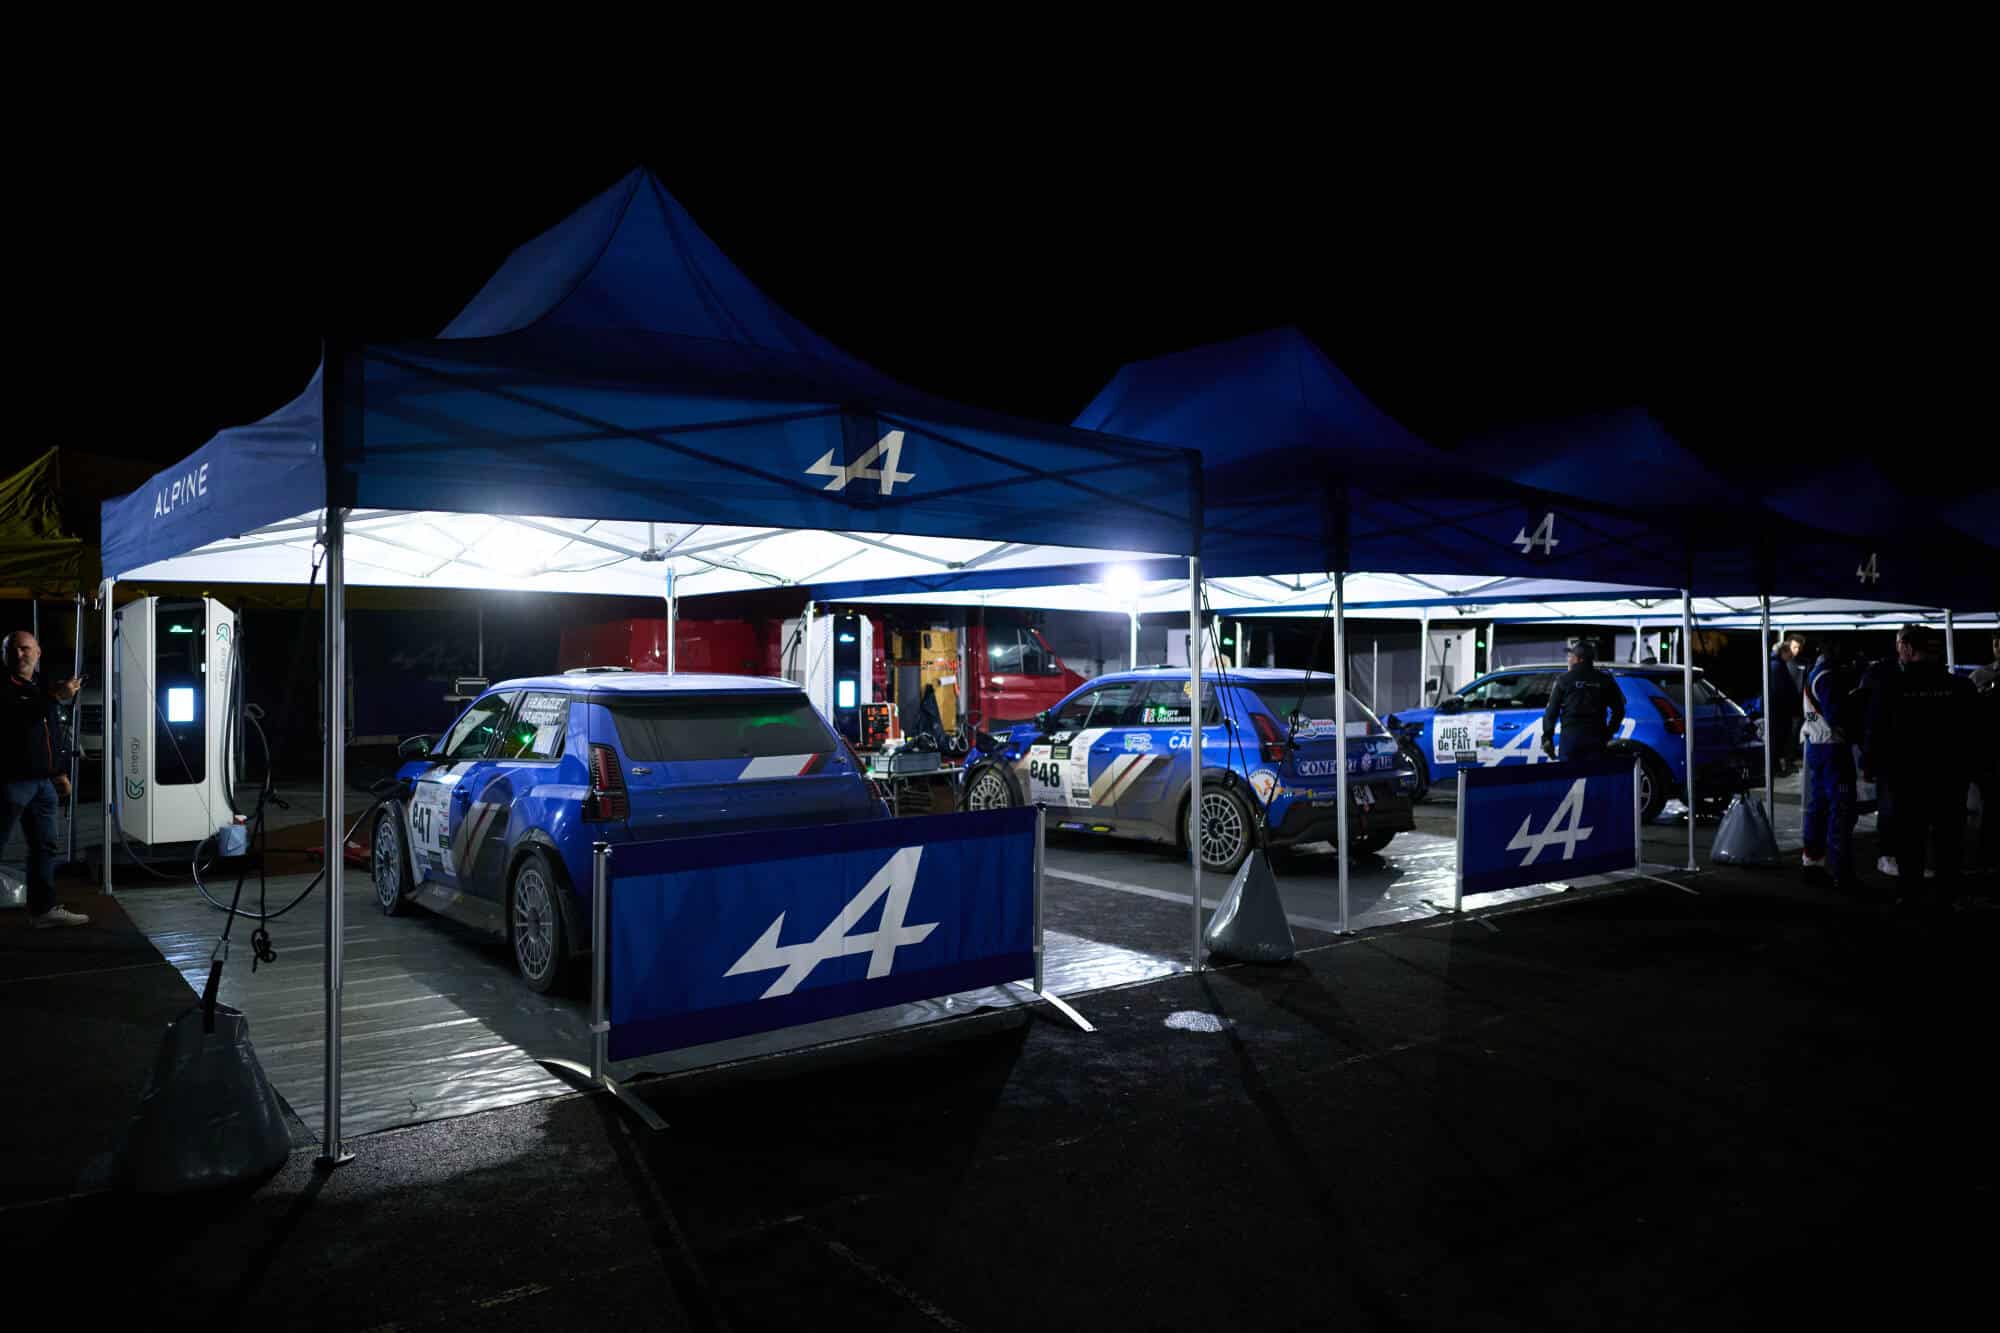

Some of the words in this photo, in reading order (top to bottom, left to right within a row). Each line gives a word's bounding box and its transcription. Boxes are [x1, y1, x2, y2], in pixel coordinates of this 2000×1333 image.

[153, 462, 209, 519] ALPINE
[1440, 727, 1469, 740] JUGES
[1452, 738, 1471, 751] FAIT
[1030, 760, 1060, 788] e48
[412, 800, 432, 845] e47
